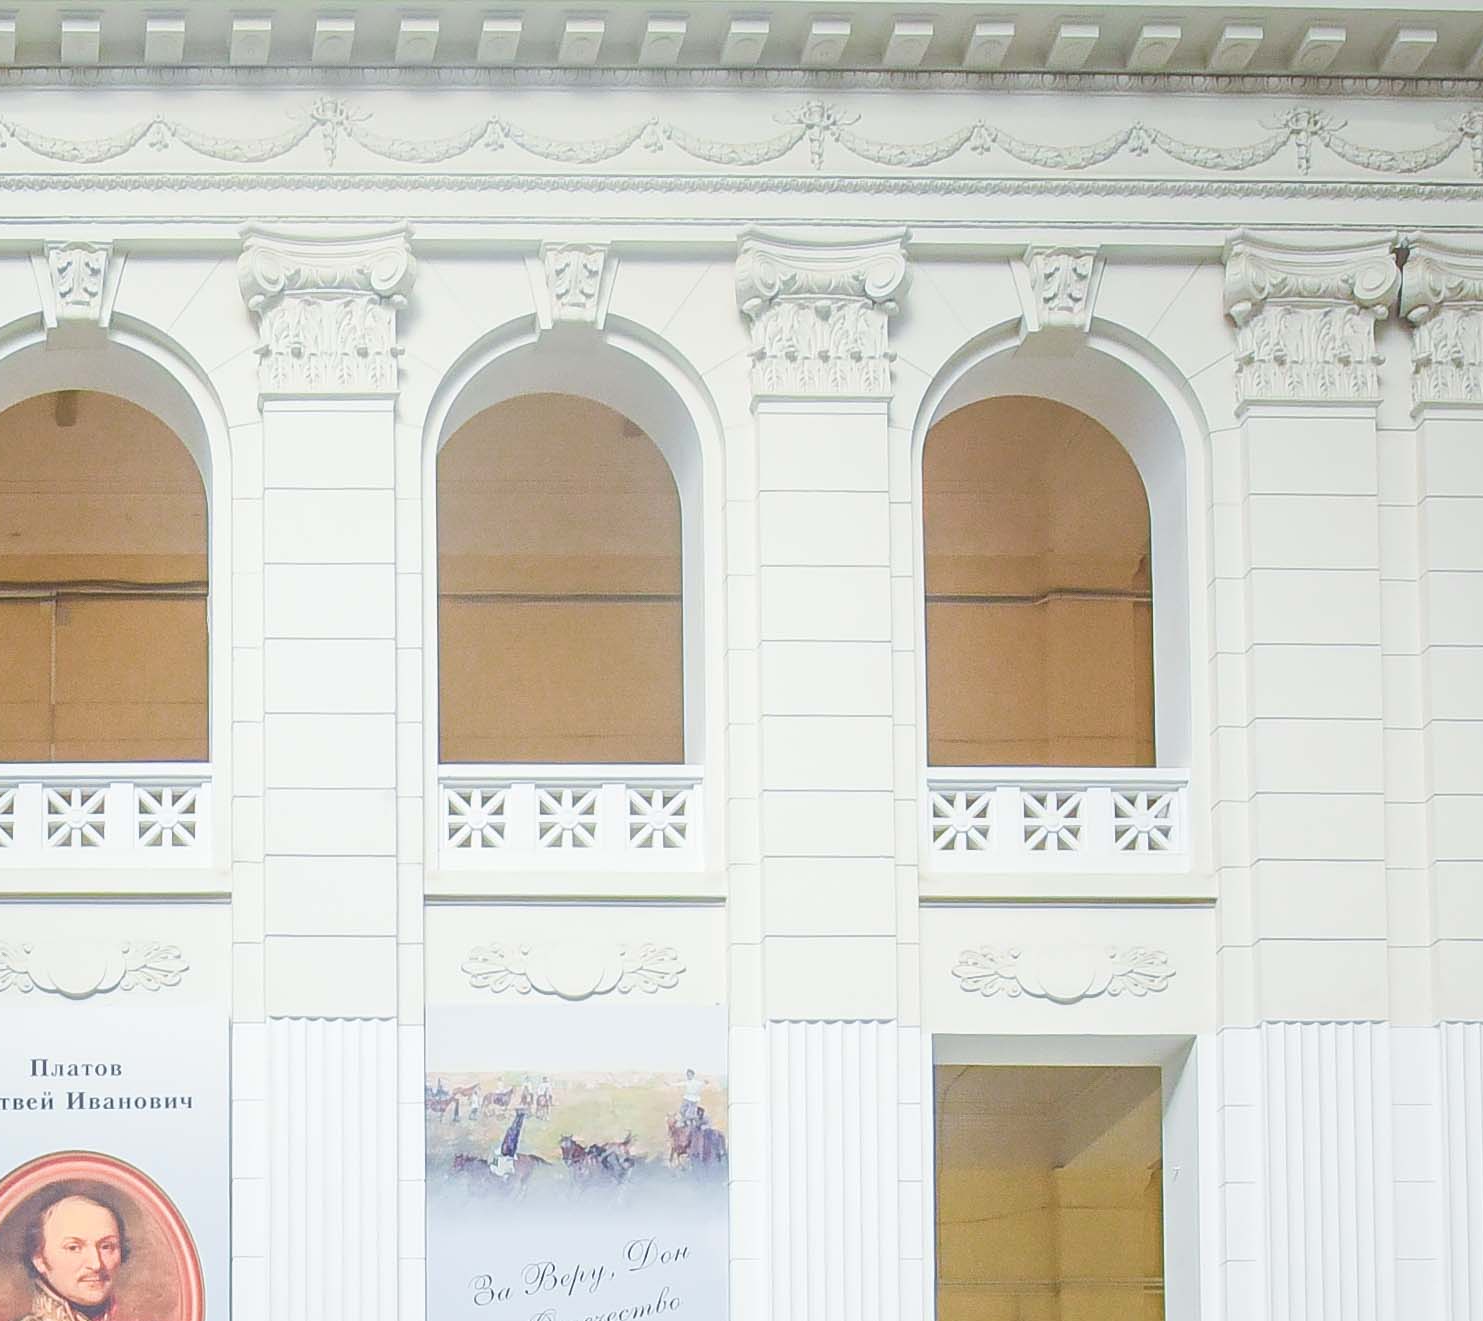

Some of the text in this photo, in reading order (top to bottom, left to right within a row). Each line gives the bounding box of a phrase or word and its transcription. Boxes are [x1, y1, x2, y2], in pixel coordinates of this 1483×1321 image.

[29, 1058, 123, 1077] Платов
[66, 1091, 194, 1111] Иванович
[468, 1237, 690, 1306] За Веру, Дон
